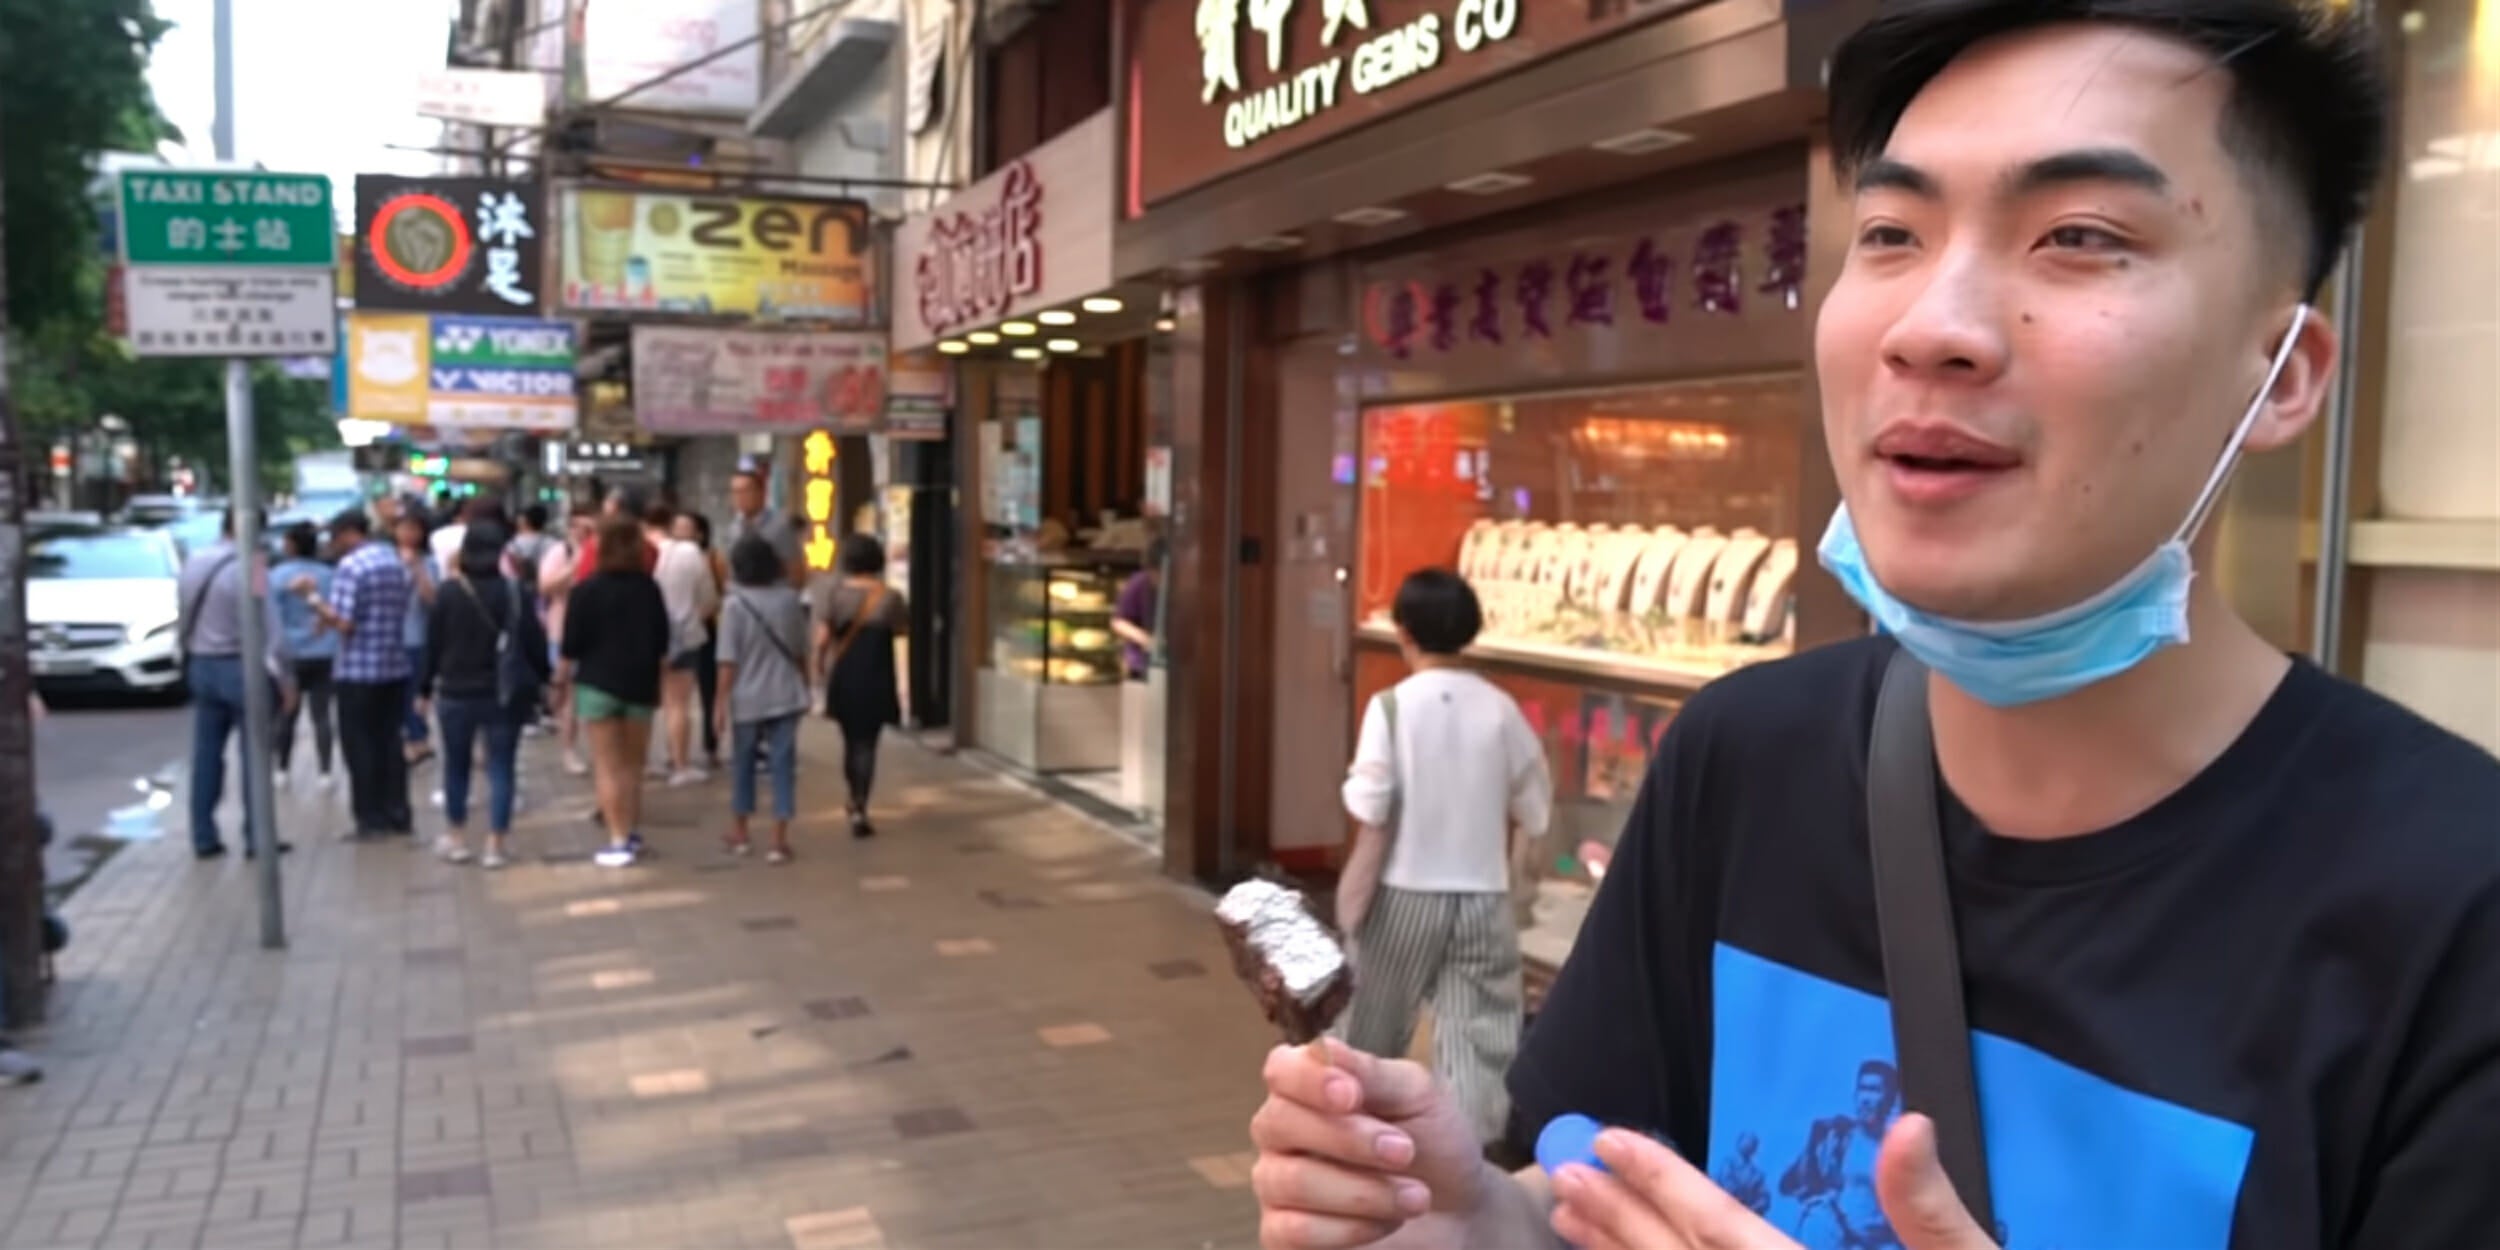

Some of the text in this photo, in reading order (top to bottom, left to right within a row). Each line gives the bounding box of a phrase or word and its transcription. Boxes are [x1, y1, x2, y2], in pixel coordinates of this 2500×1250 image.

[1223, 56, 1341, 148] QUALITY
[1350, 13, 1440, 94] GEMS
[129, 179, 323, 207] TAXI STAND
[166, 216, 292, 251] 的士站
[476, 191, 535, 306] 沐足
[490, 328, 573, 356] YONEX
[467, 370, 573, 394] VICTOR
